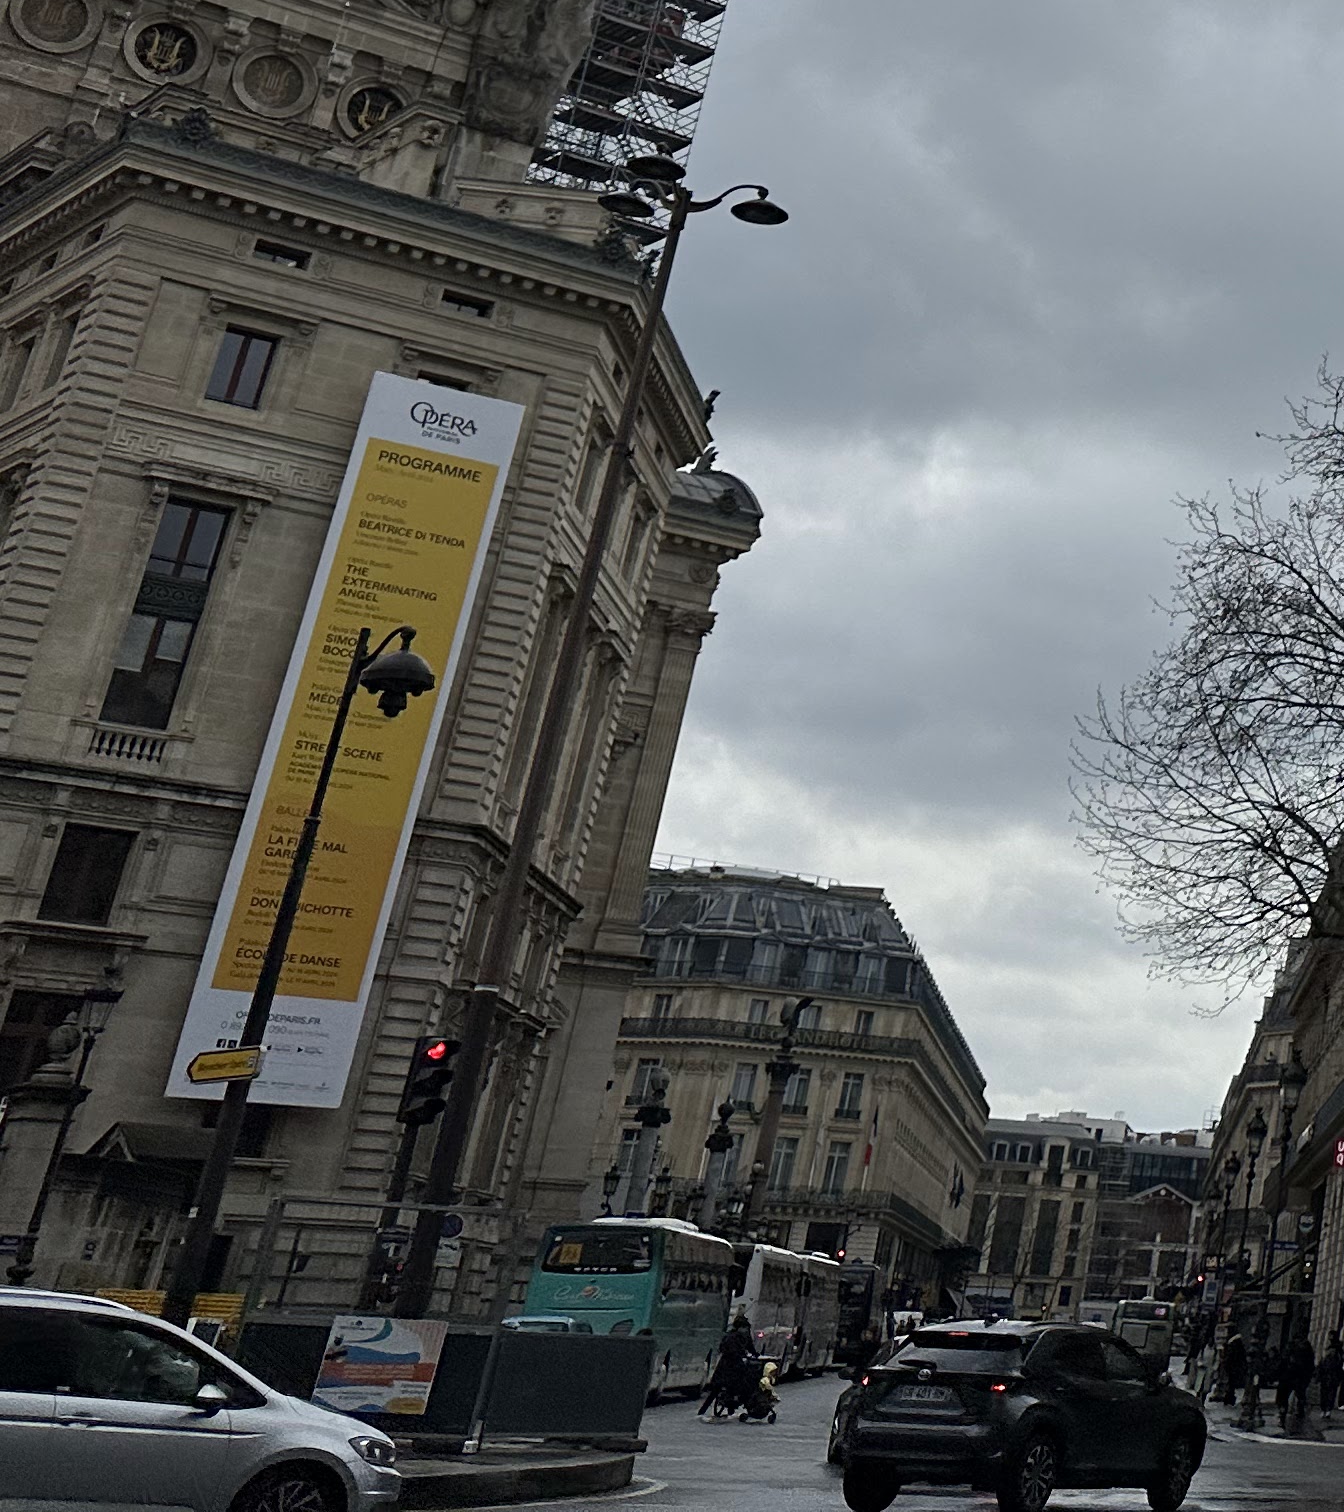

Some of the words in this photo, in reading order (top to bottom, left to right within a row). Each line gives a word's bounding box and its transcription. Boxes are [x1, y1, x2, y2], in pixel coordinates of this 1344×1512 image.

[410, 401, 478, 438] OPÉRA
[378, 450, 483, 483] PROGRAMME
[366, 490, 408, 509] OPÉRAS
[358, 518, 414, 538] BEATRICE
[429, 532, 466, 549] TENDA
[346, 563, 370, 577] THE
[338, 586, 379, 603] ANGEL
[342, 575, 438, 601] EXTERMINATING
[325, 632, 357, 646] SIMO
[308, 690, 343, 706] MÉD
[294, 738, 342, 754] STRE
[342, 746, 385, 762] SCENE
[268, 833, 284, 846] LA
[286, 836, 321, 851] FIE
[321, 841, 348, 854] MAL
[264, 846, 315, 863] GARDE
[249, 896, 280, 910] DON
[235, 945, 267, 960] ÉCOL
[299, 954, 342, 968] DANSE
